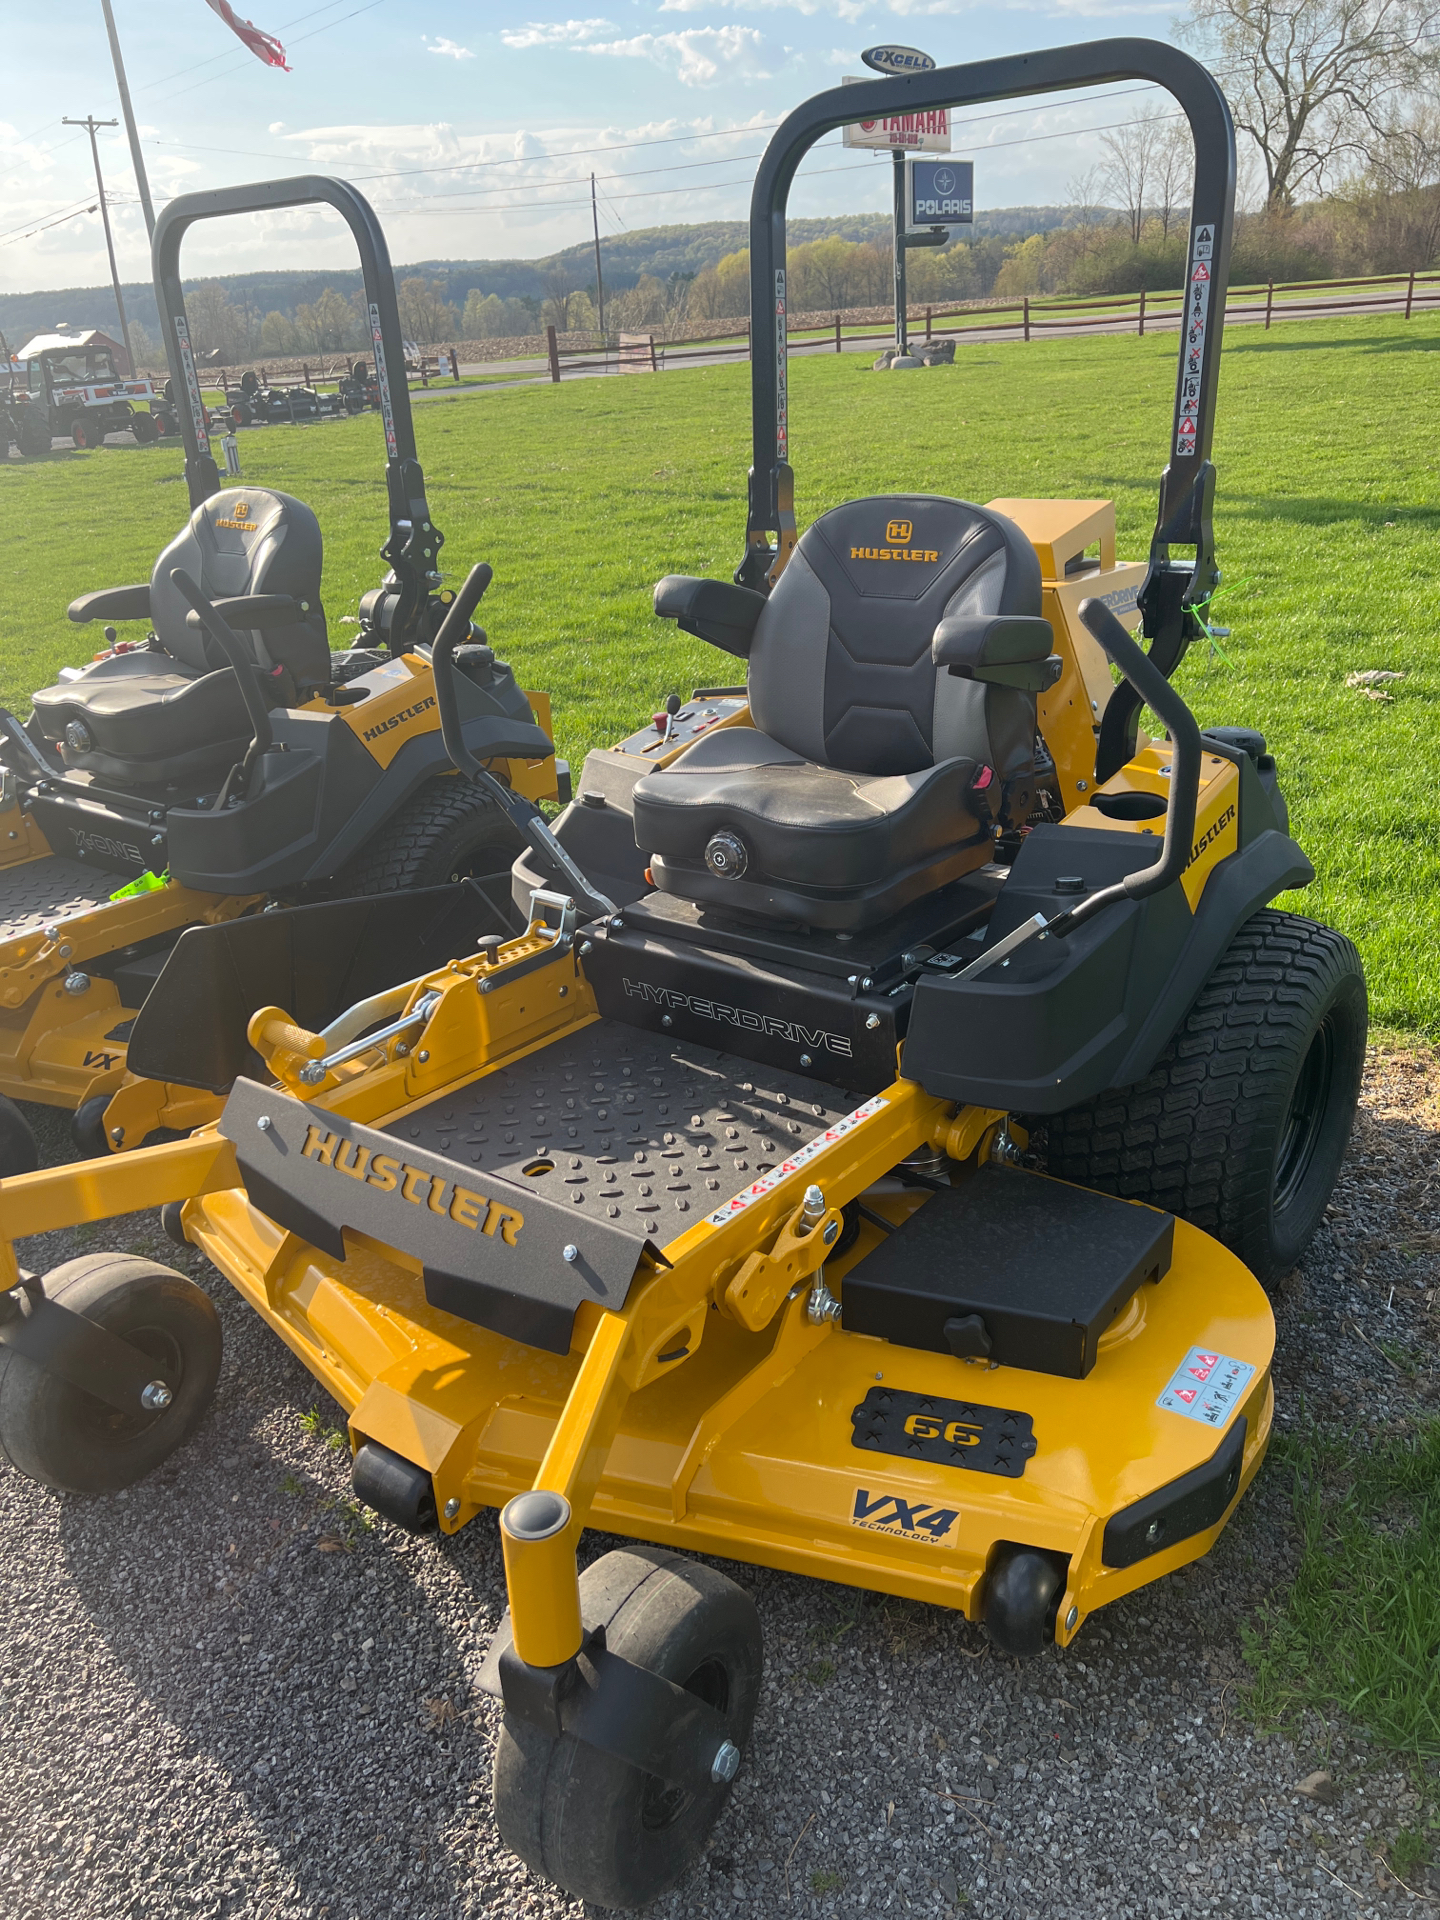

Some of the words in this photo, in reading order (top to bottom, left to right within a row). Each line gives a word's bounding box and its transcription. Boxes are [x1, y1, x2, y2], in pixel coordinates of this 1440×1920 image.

[874, 51, 929, 68] EXCELL
[916, 200, 971, 215] POLARIS
[216, 518, 257, 532] HUSTLER
[850, 547, 939, 562] HUSTLER
[363, 696, 436, 742] HUSTLER
[68, 827, 145, 865] X-ONE
[1187, 804, 1236, 867] USTLER
[623, 978, 853, 1058] HYPERDRIVE
[83, 1051, 122, 1070] VX
[300, 1124, 525, 1248] HUSTLER
[903, 1413, 984, 1447] 66
[853, 1489, 960, 1538] VX4
[852, 1518, 940, 1544] TECHNOLOGY
